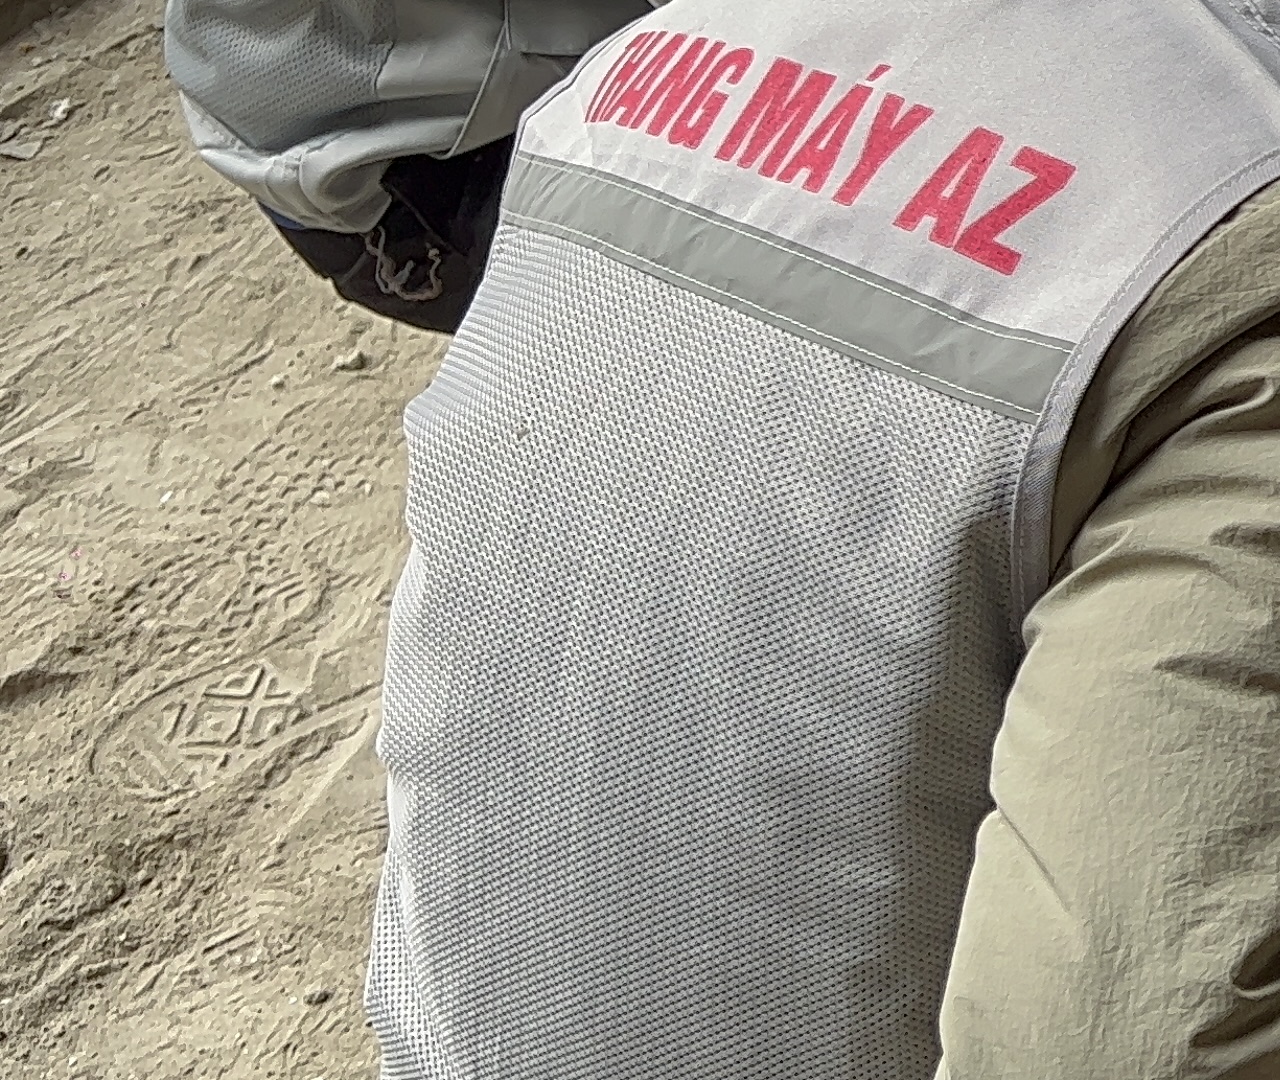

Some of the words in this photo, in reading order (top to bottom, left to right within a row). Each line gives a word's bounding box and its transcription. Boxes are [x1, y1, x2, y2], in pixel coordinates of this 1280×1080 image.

[584, 30, 755, 151] THANG
[714, 63, 935, 207] MÁY
[892, 126, 1077, 277] AZ
